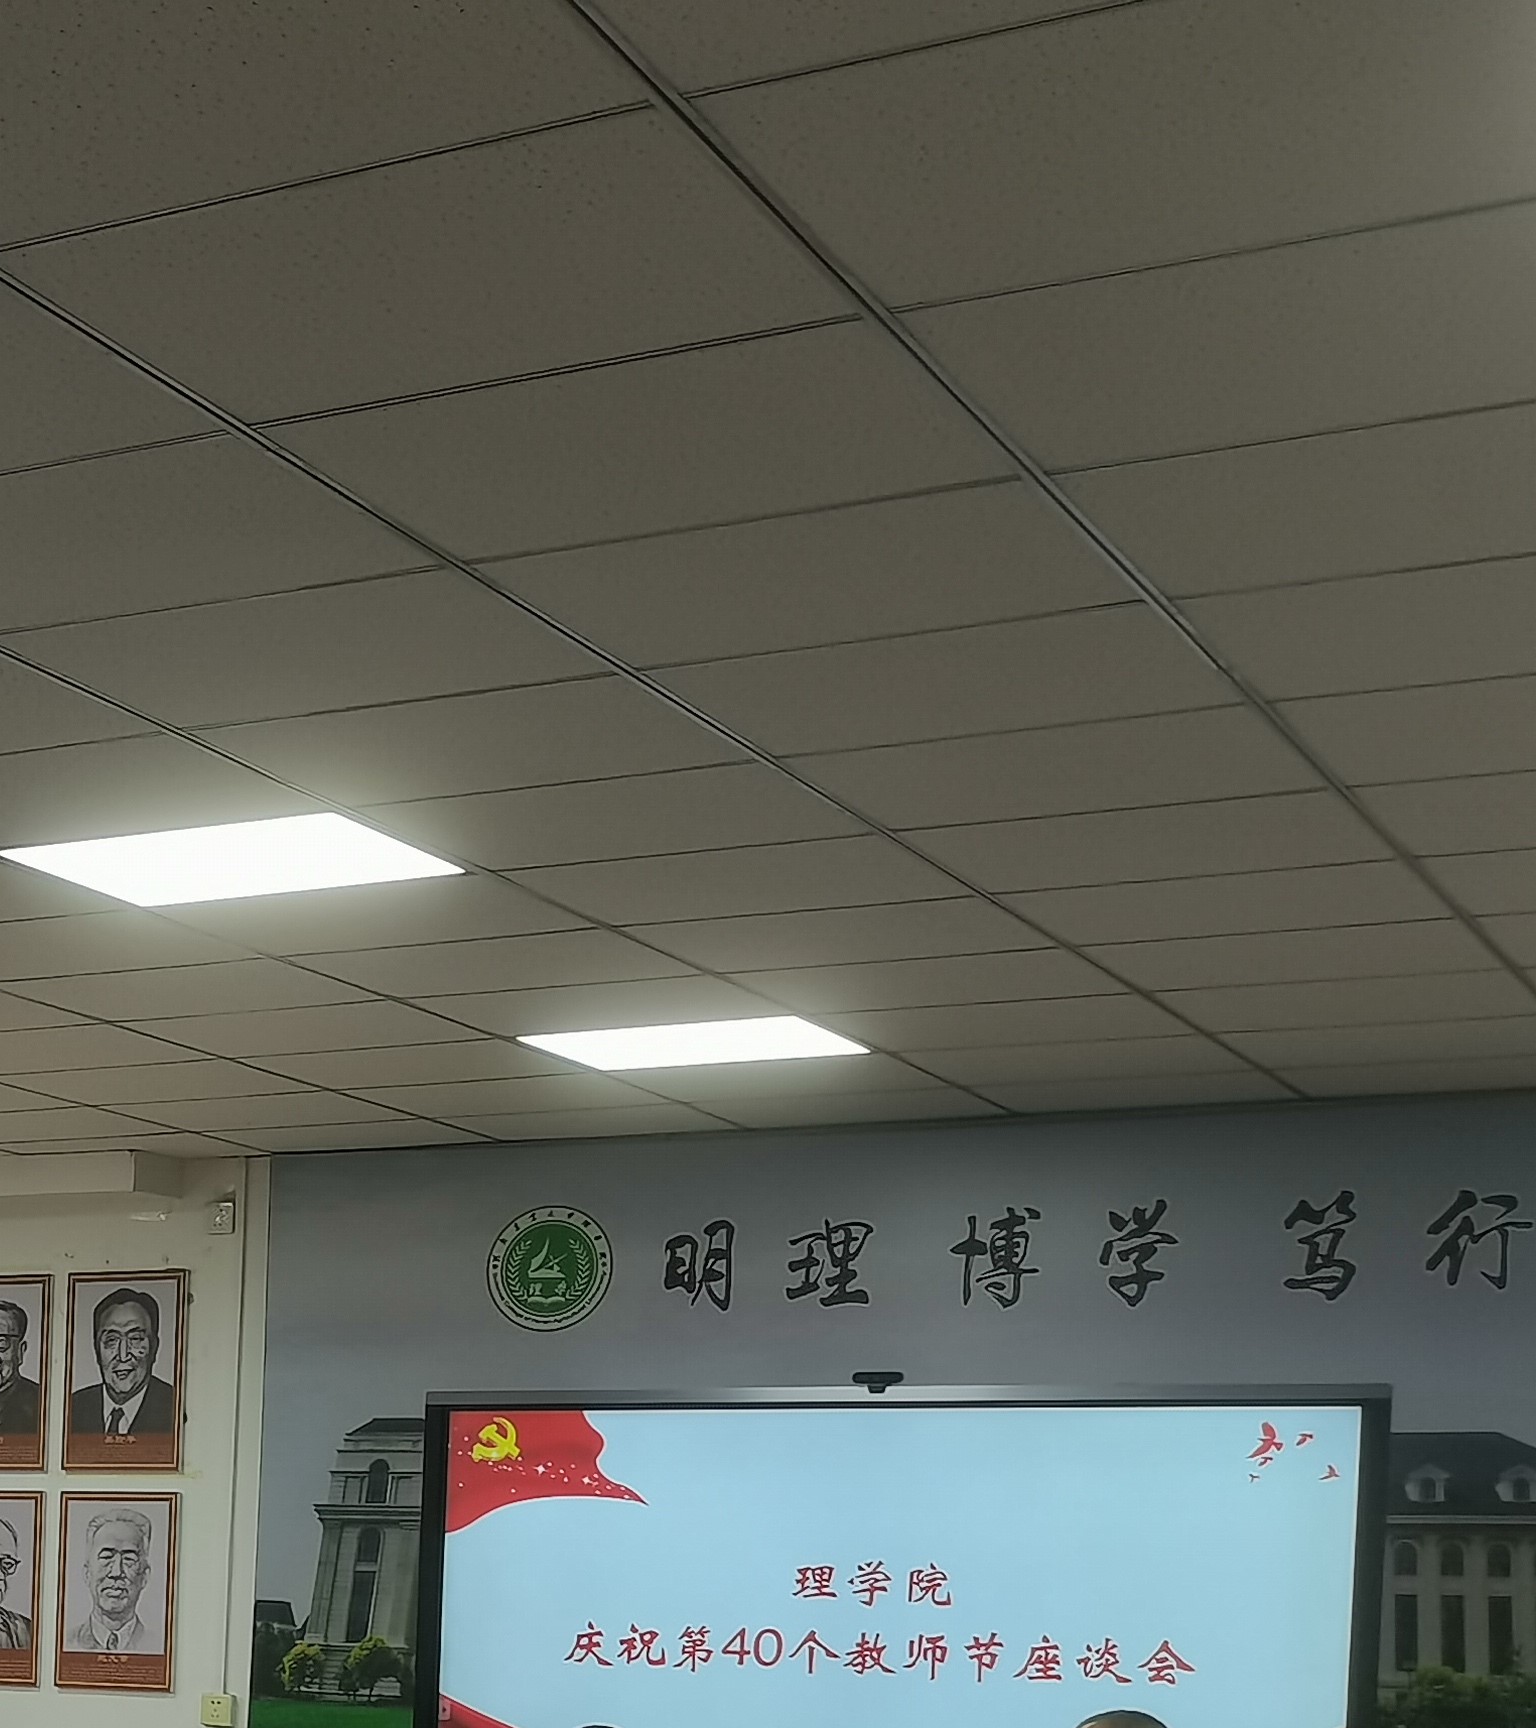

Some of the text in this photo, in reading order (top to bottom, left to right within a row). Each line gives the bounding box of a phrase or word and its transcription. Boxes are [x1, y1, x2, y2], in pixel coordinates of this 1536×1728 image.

[663, 1219, 874, 1312] 明理
[949, 1199, 1179, 1309] 博学
[1283, 1189, 1535, 1302] 笃行
[792, 1560, 952, 1607] 理学院
[564, 1621, 1195, 1685] 庆祝第40个教师节座谈会
